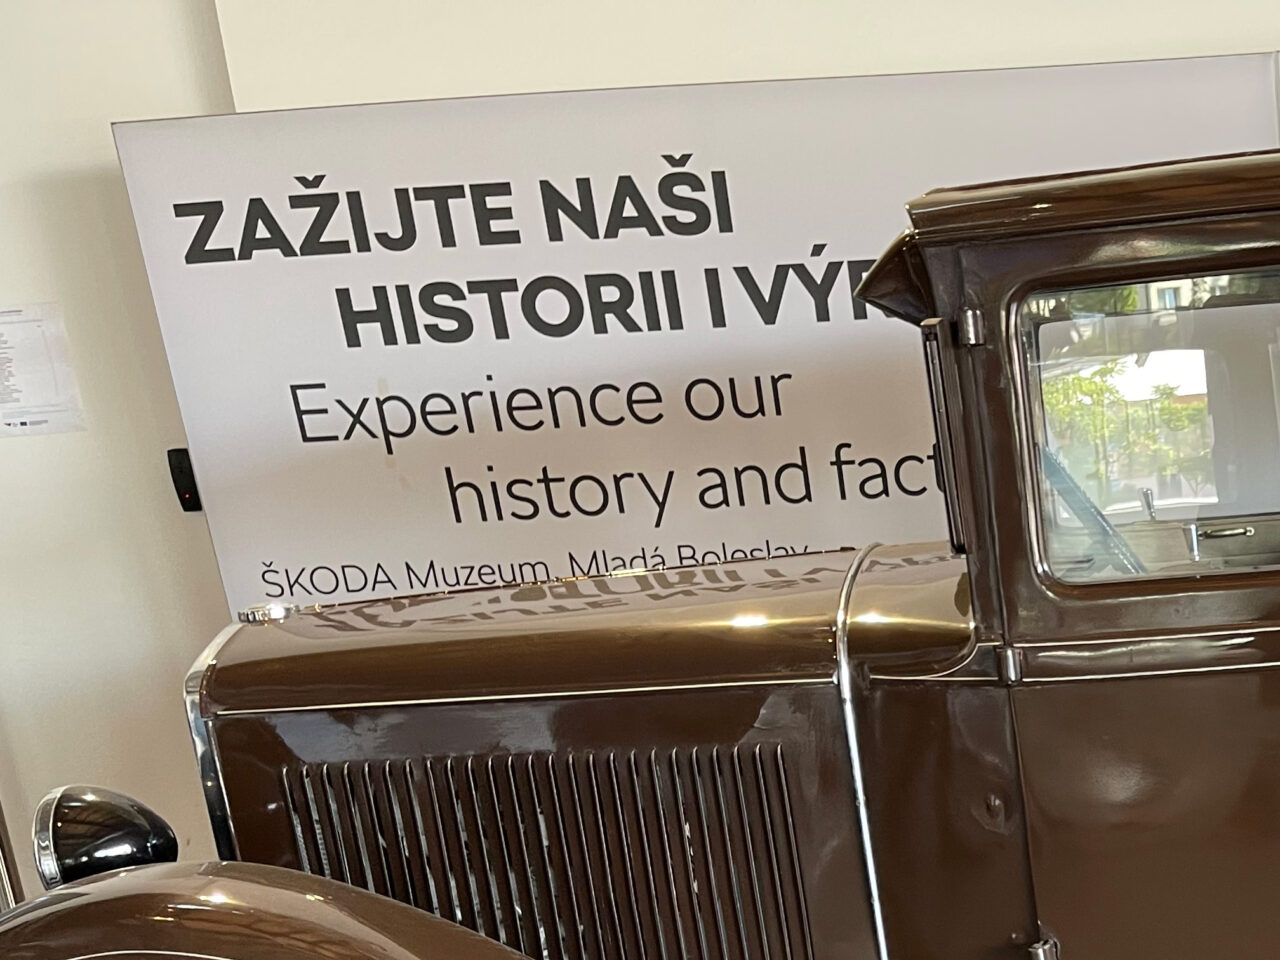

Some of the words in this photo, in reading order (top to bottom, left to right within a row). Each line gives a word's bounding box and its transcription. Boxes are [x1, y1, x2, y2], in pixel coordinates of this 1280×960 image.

[172, 174, 522, 265] ZAŽIJTE
[538, 153, 734, 243] NAŠI
[334, 269, 684, 348] HISTORII
[704, 267, 727, 328] I
[289, 374, 664, 456] Experience
[684, 372, 793, 421] our
[444, 465, 675, 528] history
[696, 446, 812, 509] and
[261, 561, 398, 598] ŠKODA
[568, 546, 666, 577] Mladá
